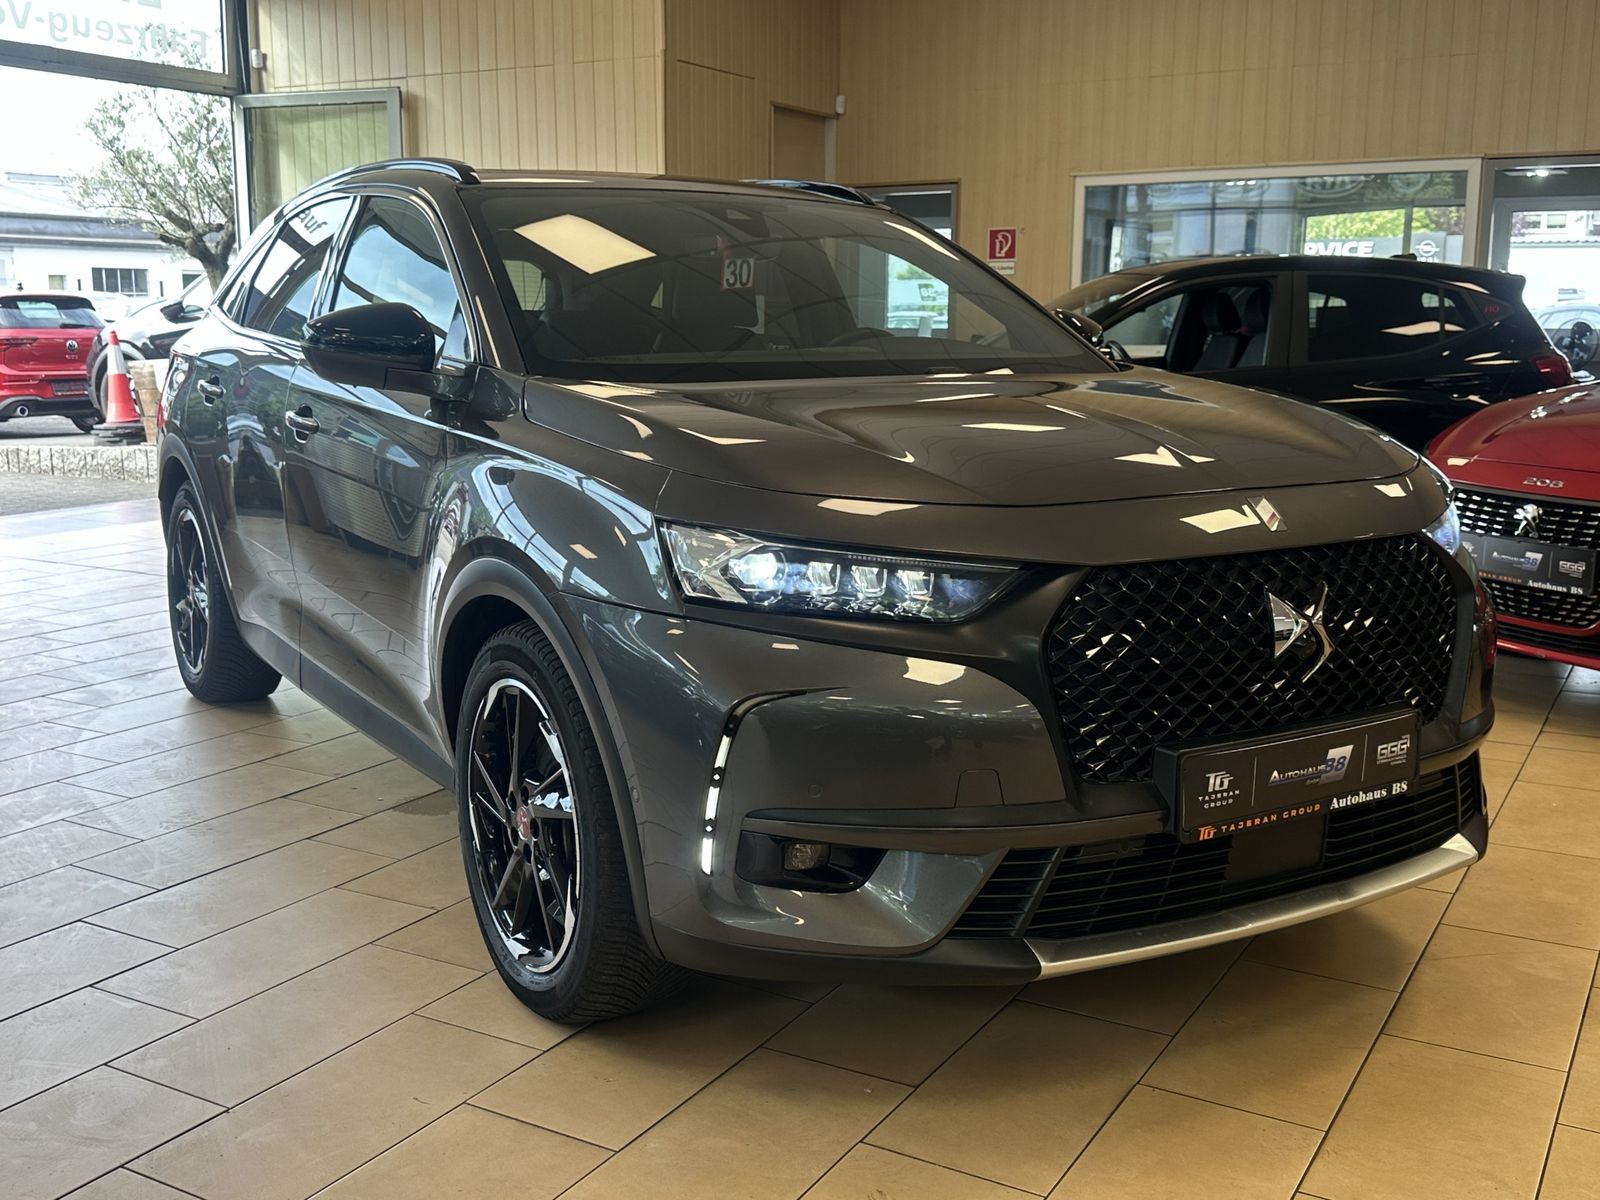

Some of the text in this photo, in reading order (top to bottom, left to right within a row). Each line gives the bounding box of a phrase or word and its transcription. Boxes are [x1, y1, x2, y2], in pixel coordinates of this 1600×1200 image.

[725, 259, 752, 287] 30
[1527, 580, 1567, 593] Autohaus
[1203, 798, 1234, 809] GROUP
[1329, 787, 1387, 810] Autohaus
[1221, 814, 1278, 833] TAJERAN
[1282, 803, 1321, 819] GROUP
